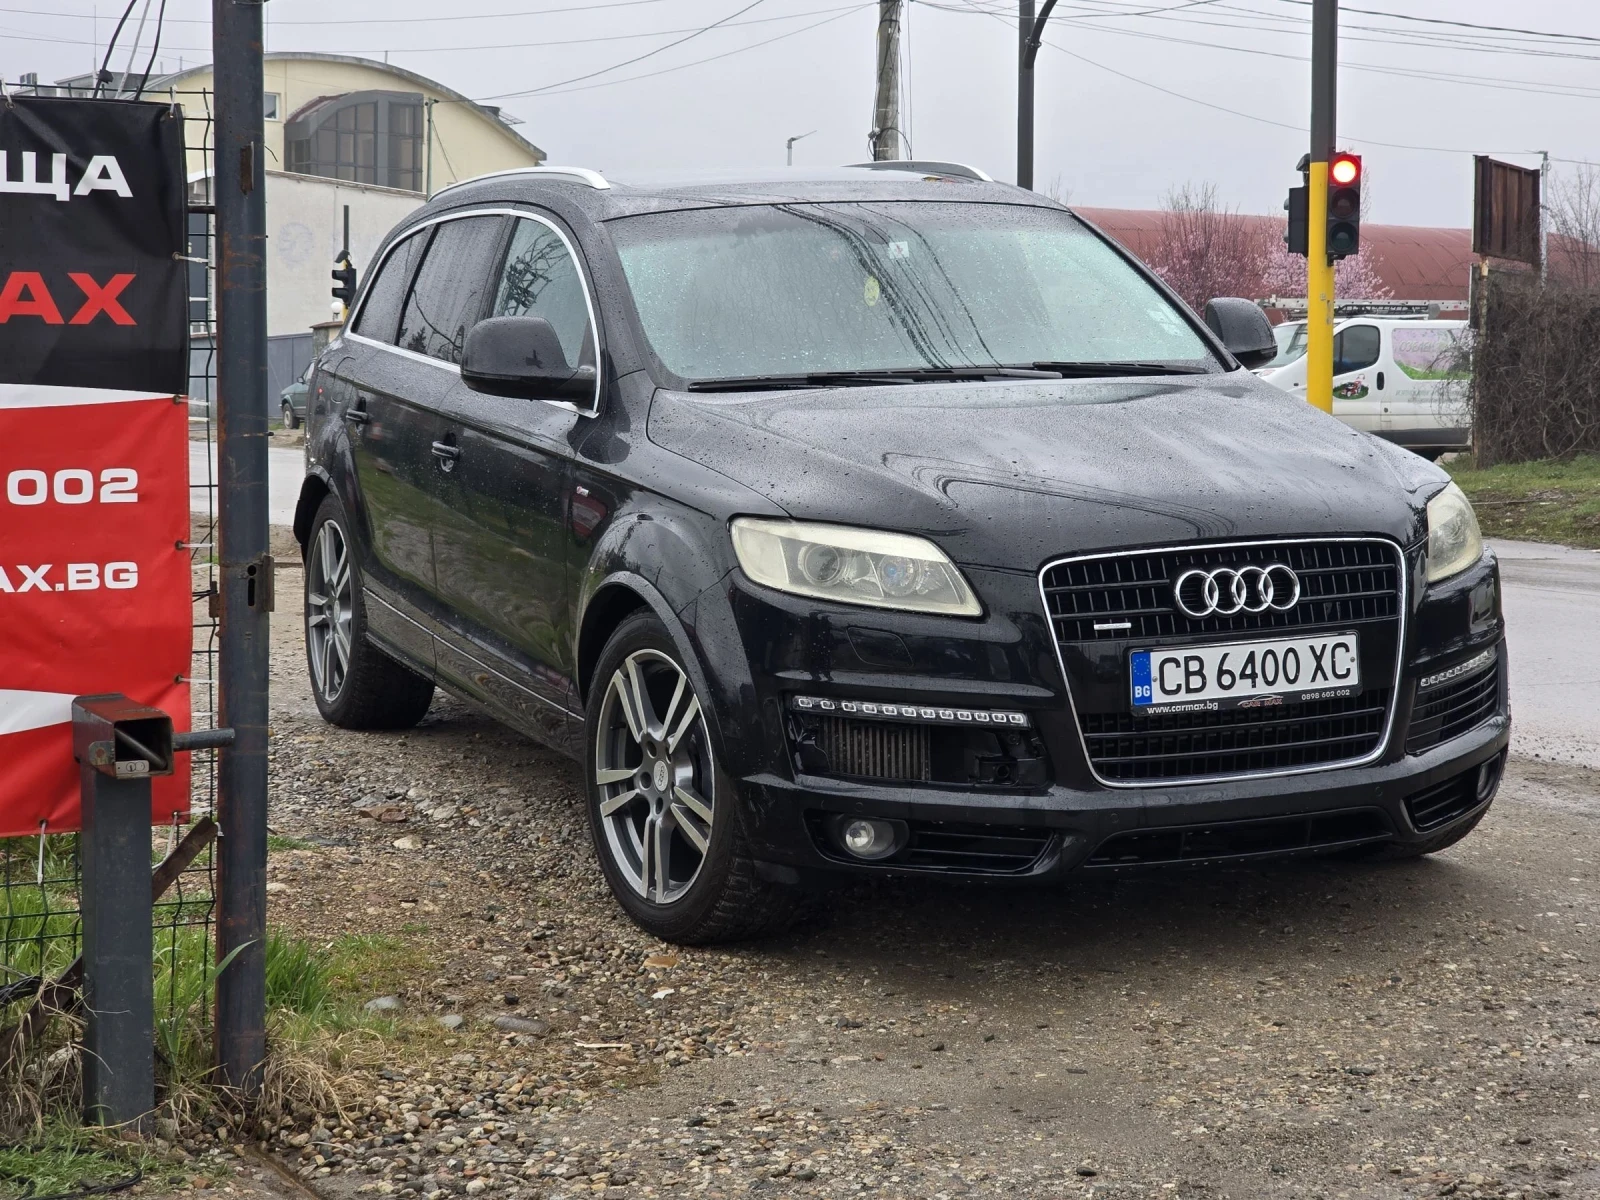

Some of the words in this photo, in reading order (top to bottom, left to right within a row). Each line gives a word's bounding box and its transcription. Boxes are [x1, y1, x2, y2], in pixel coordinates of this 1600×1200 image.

[7, 467, 139, 505] 002
[1158, 655, 1208, 696] CB
[1216, 647, 1301, 691] 6400
[1308, 642, 1351, 683] XC
[1134, 685, 1151, 698] BG
[1301, 693, 1320, 701] 0898
[1321, 690, 1335, 698] 602
[1146, 701, 1219, 714] www.carmax.bg
